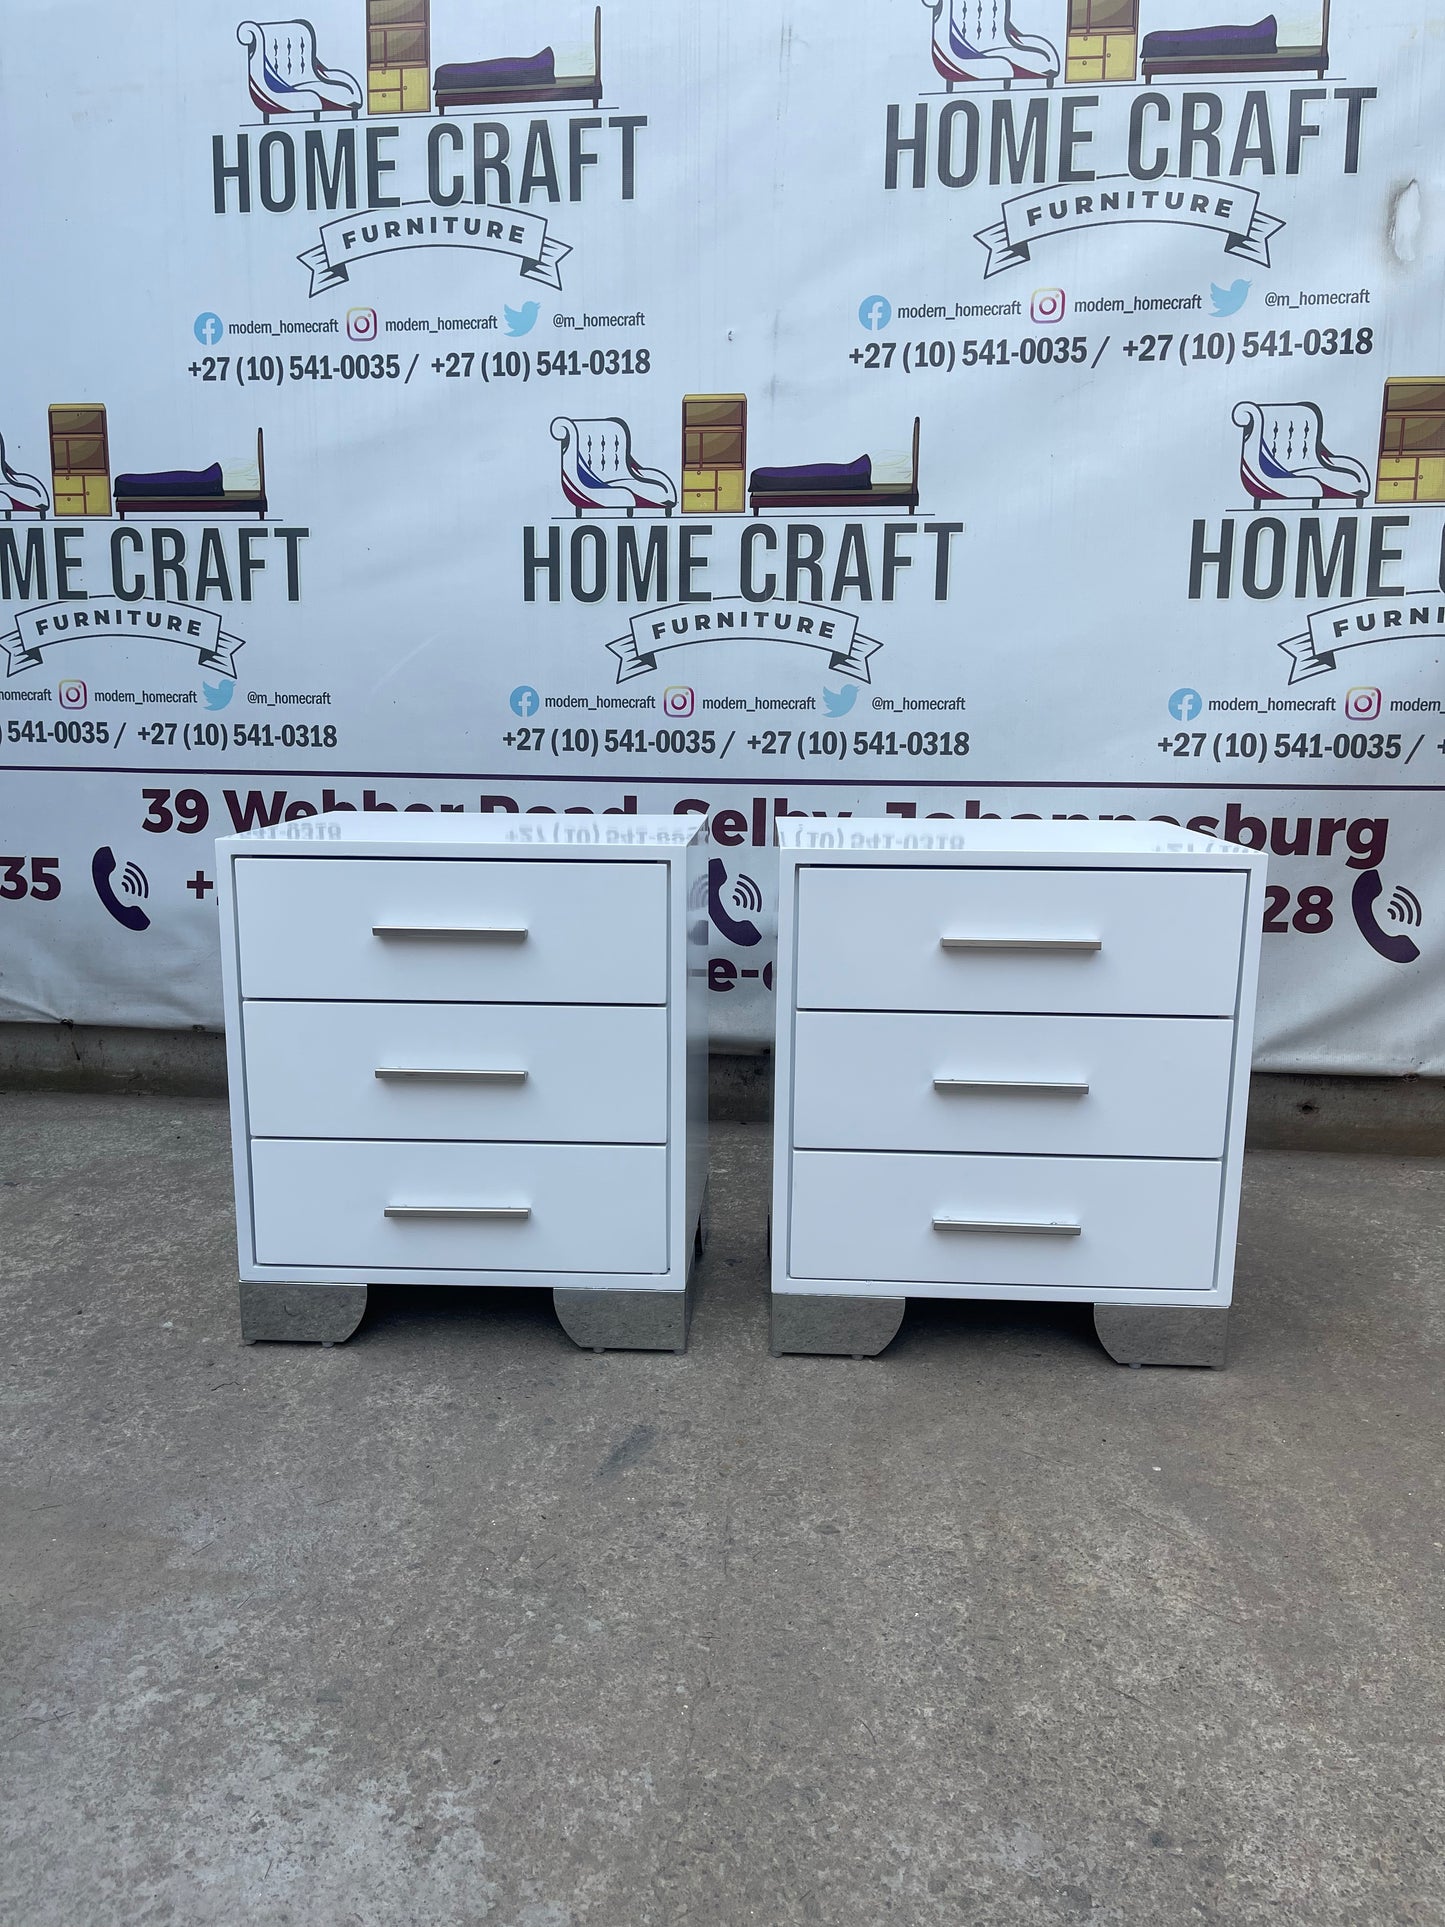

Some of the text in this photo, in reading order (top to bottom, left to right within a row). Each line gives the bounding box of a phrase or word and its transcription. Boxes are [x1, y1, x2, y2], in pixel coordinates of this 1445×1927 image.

[884, 87, 1377, 190] HOME CRAFT
[212, 115, 647, 213] HOME CRAFT
[1026, 190, 1233, 226] FURNITURE
[343, 216, 526, 249] FURNITURE
[1265, 289, 1370, 309] @m_homecraft
[553, 312, 645, 330] @m_homecraft
[110, 527, 309, 602] CRAFT
[523, 523, 964, 602] HOME CRAFT
[1188, 516, 1411, 599] HOME
[35, 609, 202, 637] FURNITURE
[652, 611, 836, 640] FURNITURE
[248, 691, 331, 706] @m_homecraft
[872, 697, 965, 712] @m_homecraft
[142, 789, 209, 834] 39
